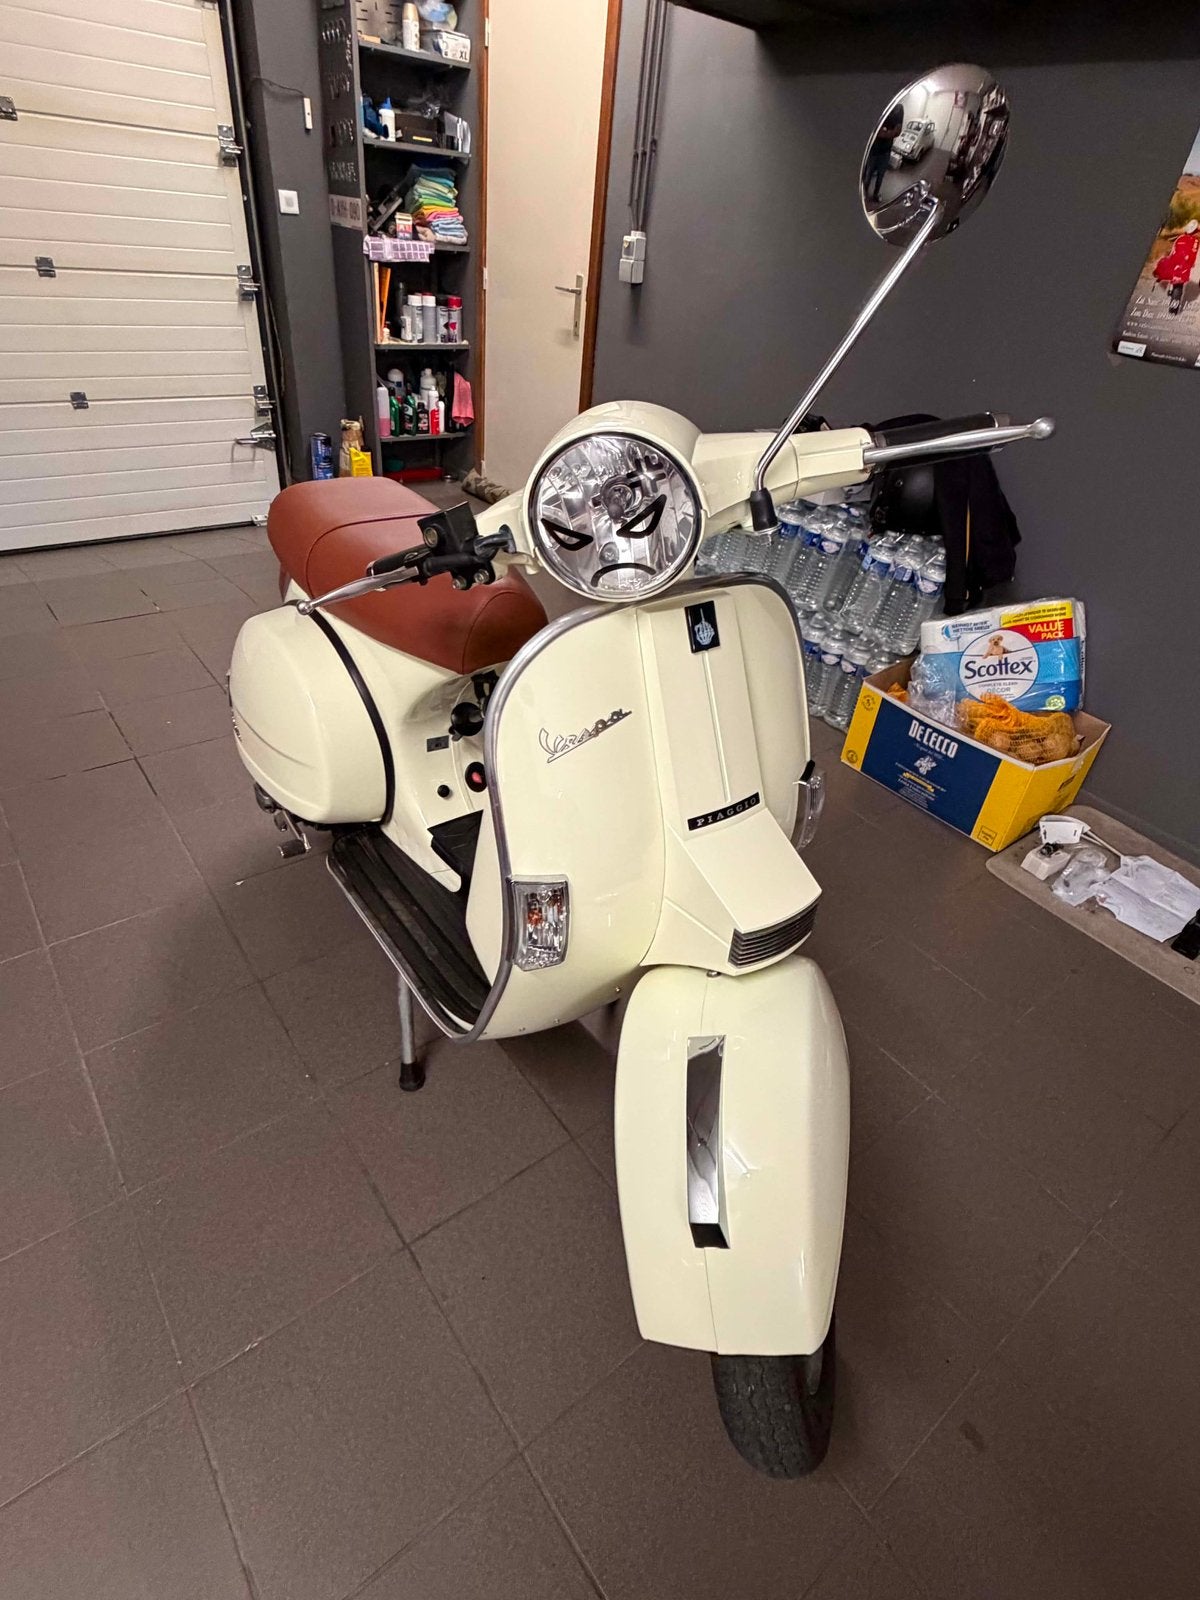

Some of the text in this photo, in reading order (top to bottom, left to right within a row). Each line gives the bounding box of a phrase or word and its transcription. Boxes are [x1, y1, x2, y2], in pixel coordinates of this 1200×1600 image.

[459, 50, 468, 60] XL
[1028, 621, 1064, 634] VALUE
[1041, 631, 1064, 640] PACK
[964, 657, 1033, 680] Scottex
[538, 708, 633, 763] Vespa
[695, 797, 758, 828] PIAGGIO
